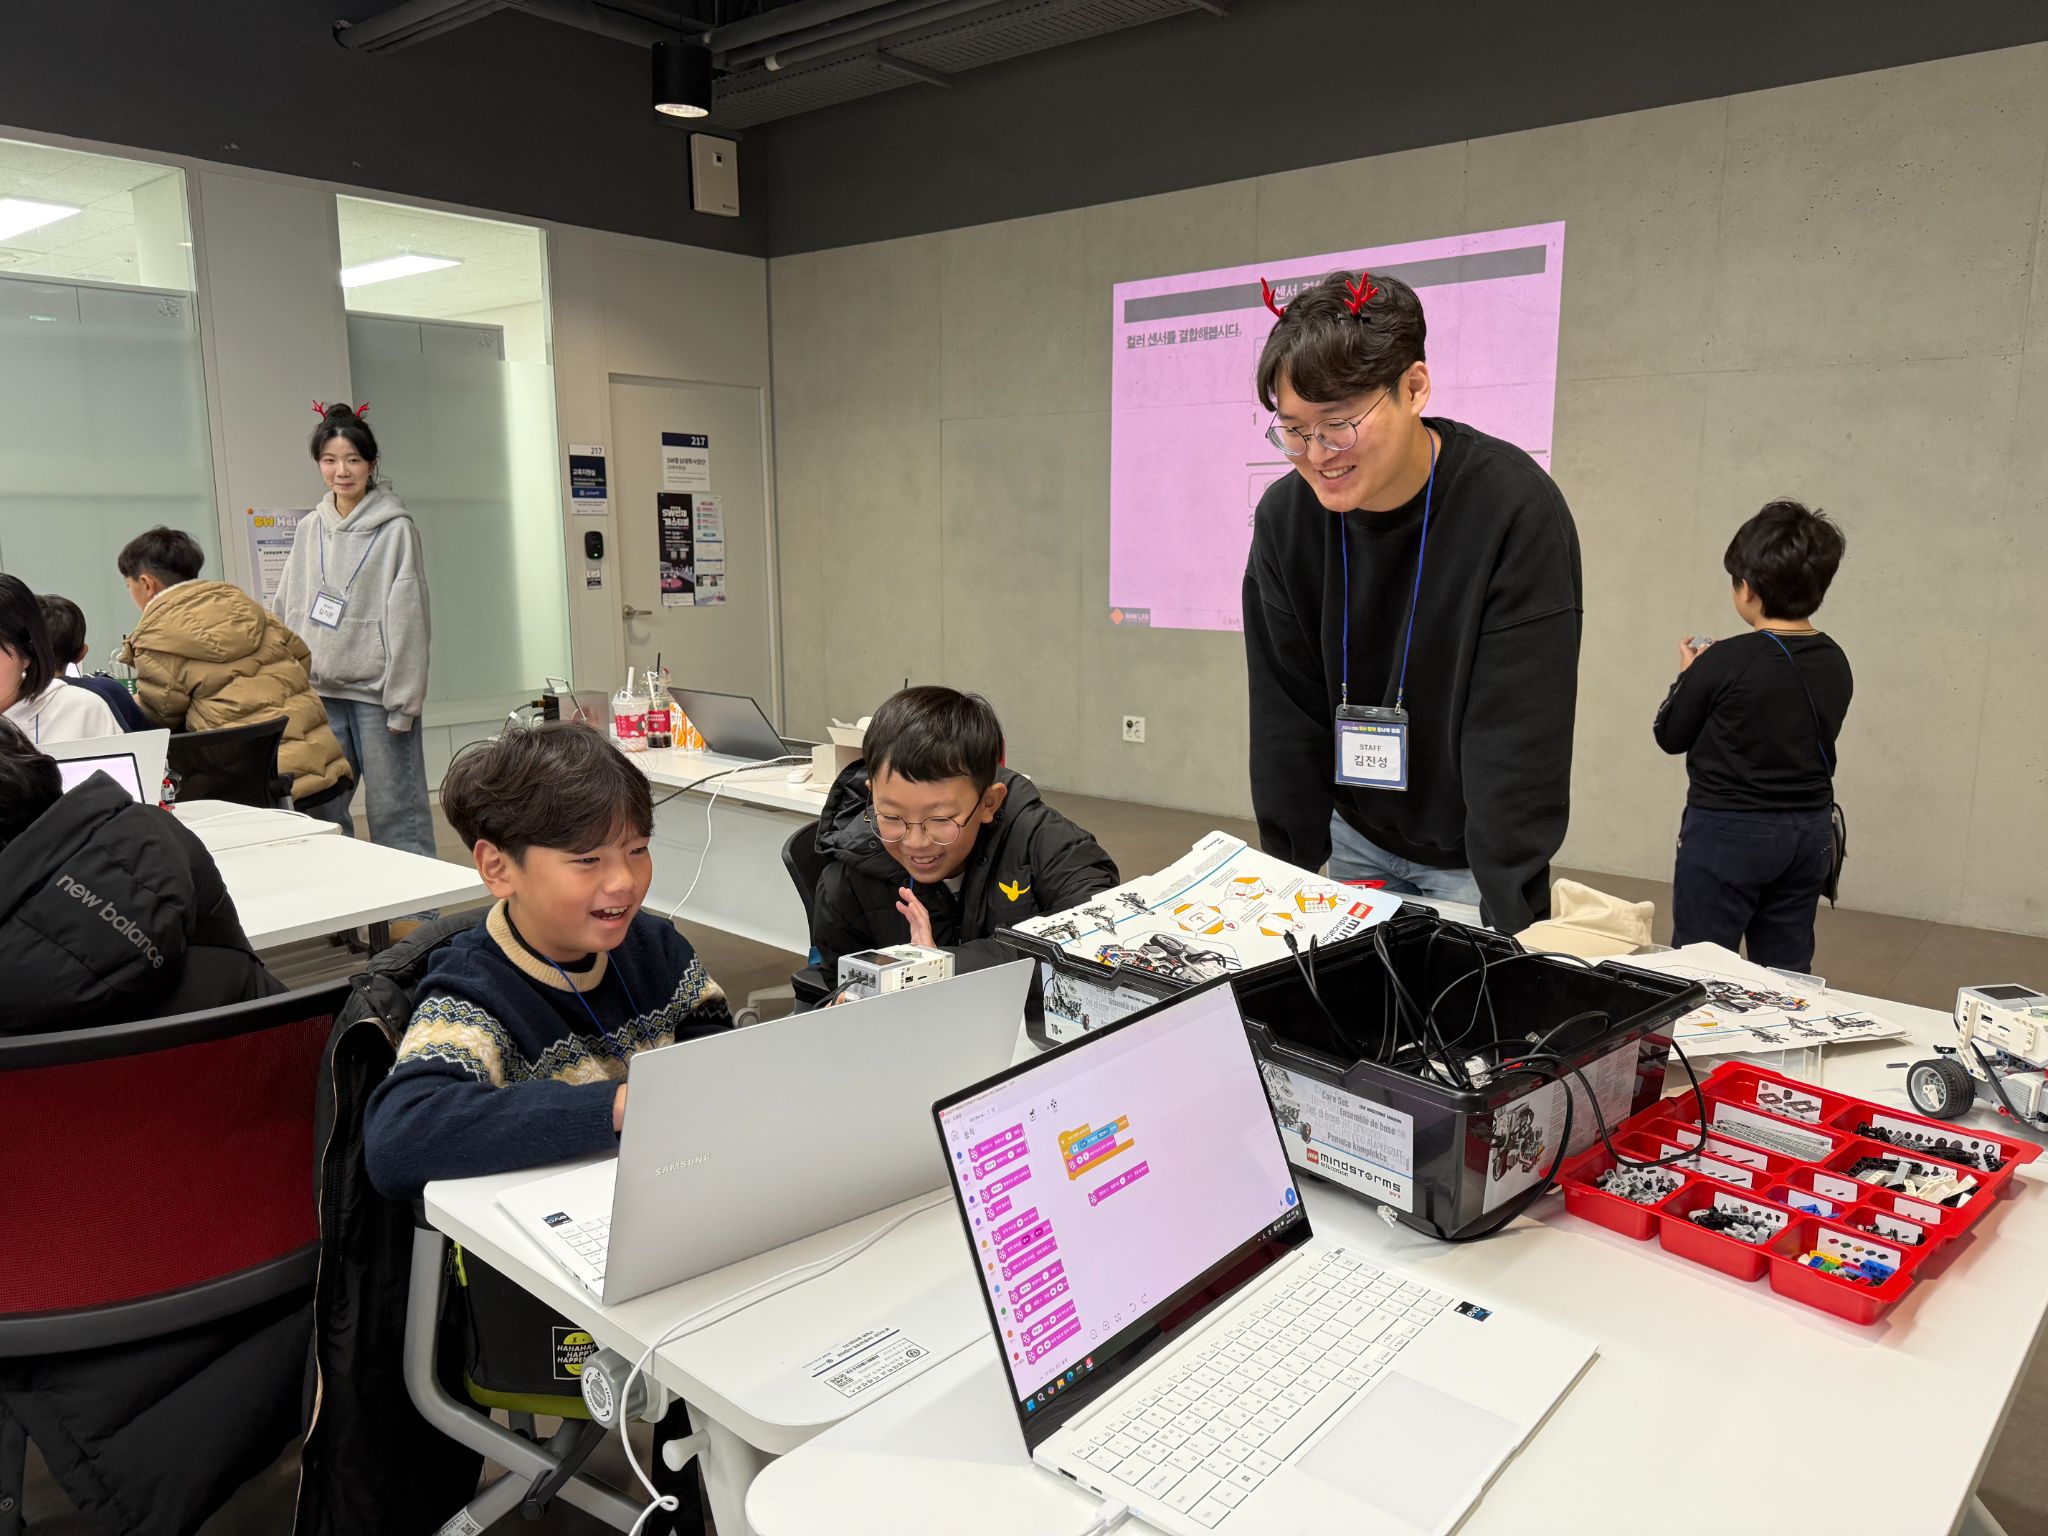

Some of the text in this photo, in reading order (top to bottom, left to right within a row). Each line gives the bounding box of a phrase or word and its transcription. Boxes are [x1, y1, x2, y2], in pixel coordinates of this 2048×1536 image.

[1127, 322, 1242, 350] 컬러 센서를 결합해봅시다.
[690, 436, 706, 446] 217
[591, 447, 603, 455] 217
[254, 516, 275, 528] SW
[1354, 755, 1388, 768] 김진성
[56, 875, 164, 968] new balance
[1319, 916, 1349, 945] education
[1051, 1023, 1063, 1035] 10+
[1370, 1119, 1379, 1130] de
[655, 1153, 711, 1176] SAMSUNG
[1466, 1306, 1481, 1318] evo
[566, 1349, 595, 1359] HAPPY
